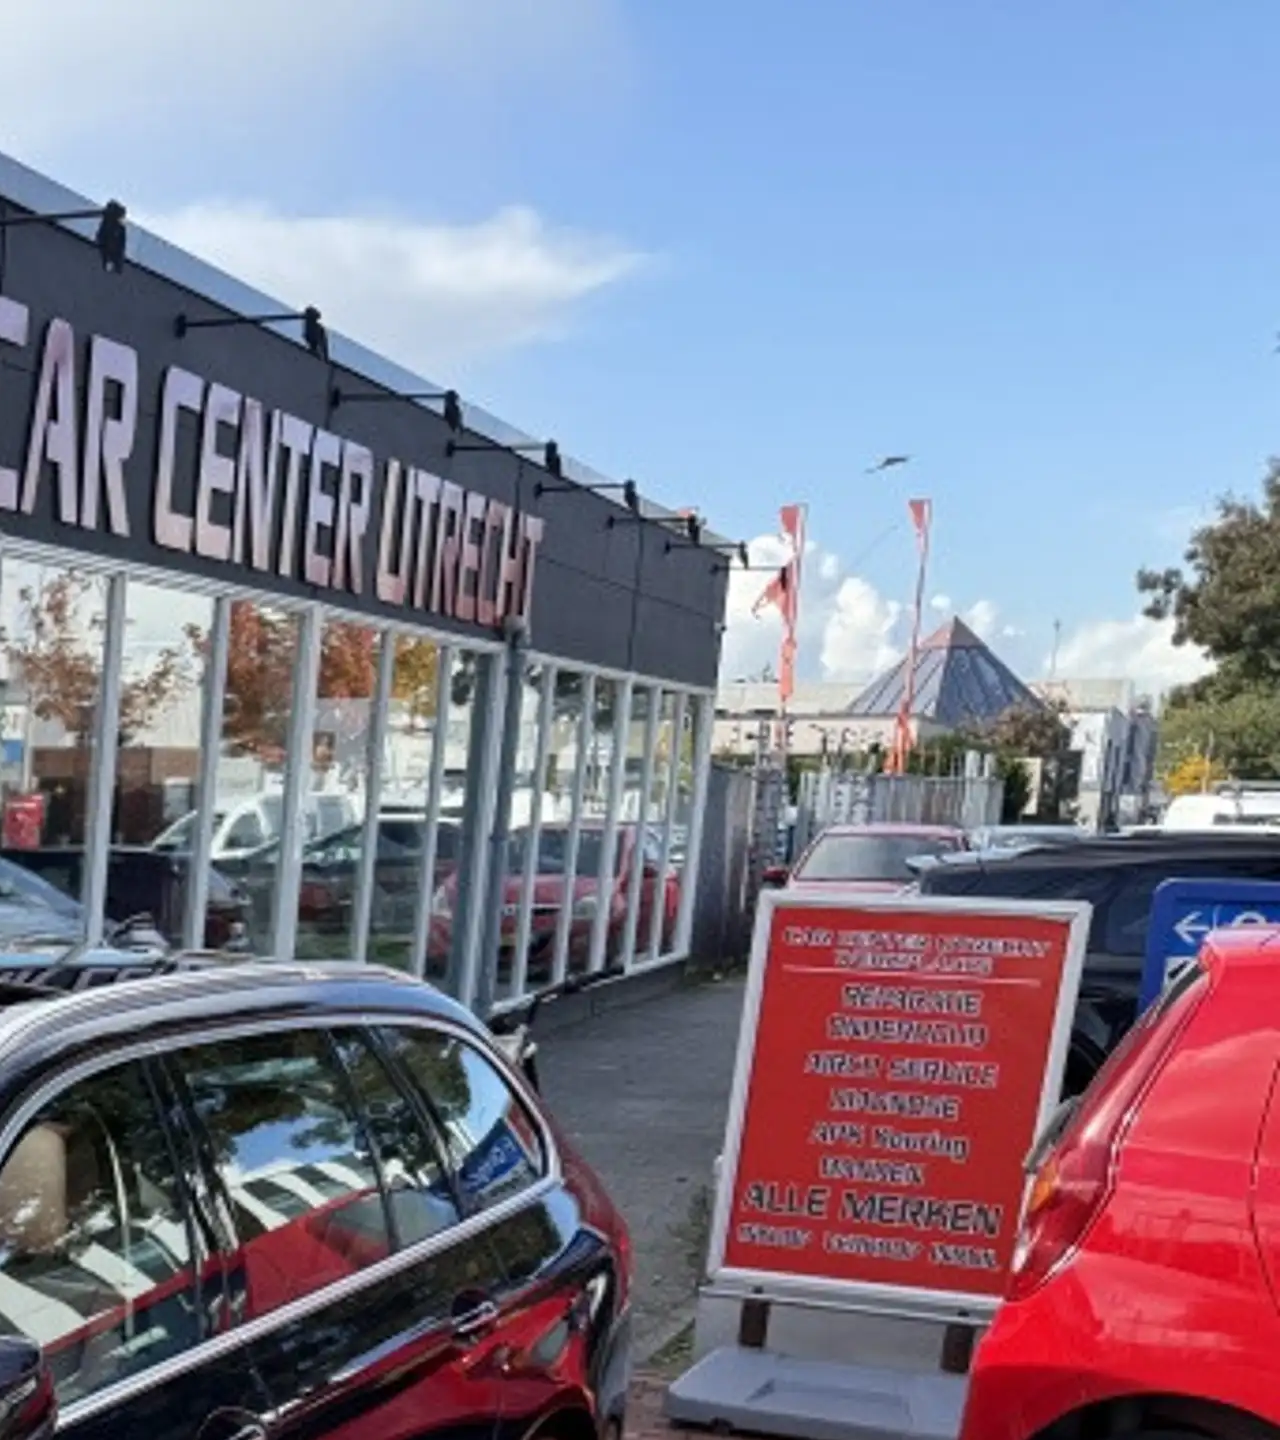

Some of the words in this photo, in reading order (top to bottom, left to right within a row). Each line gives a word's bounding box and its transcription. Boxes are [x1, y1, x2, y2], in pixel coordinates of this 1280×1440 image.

[154, 365, 374, 595] CENTER
[376, 458, 545, 640] UTRECHT
[742, 1182, 830, 1220] ALLE
[840, 1191, 1004, 1236] MERKEN
